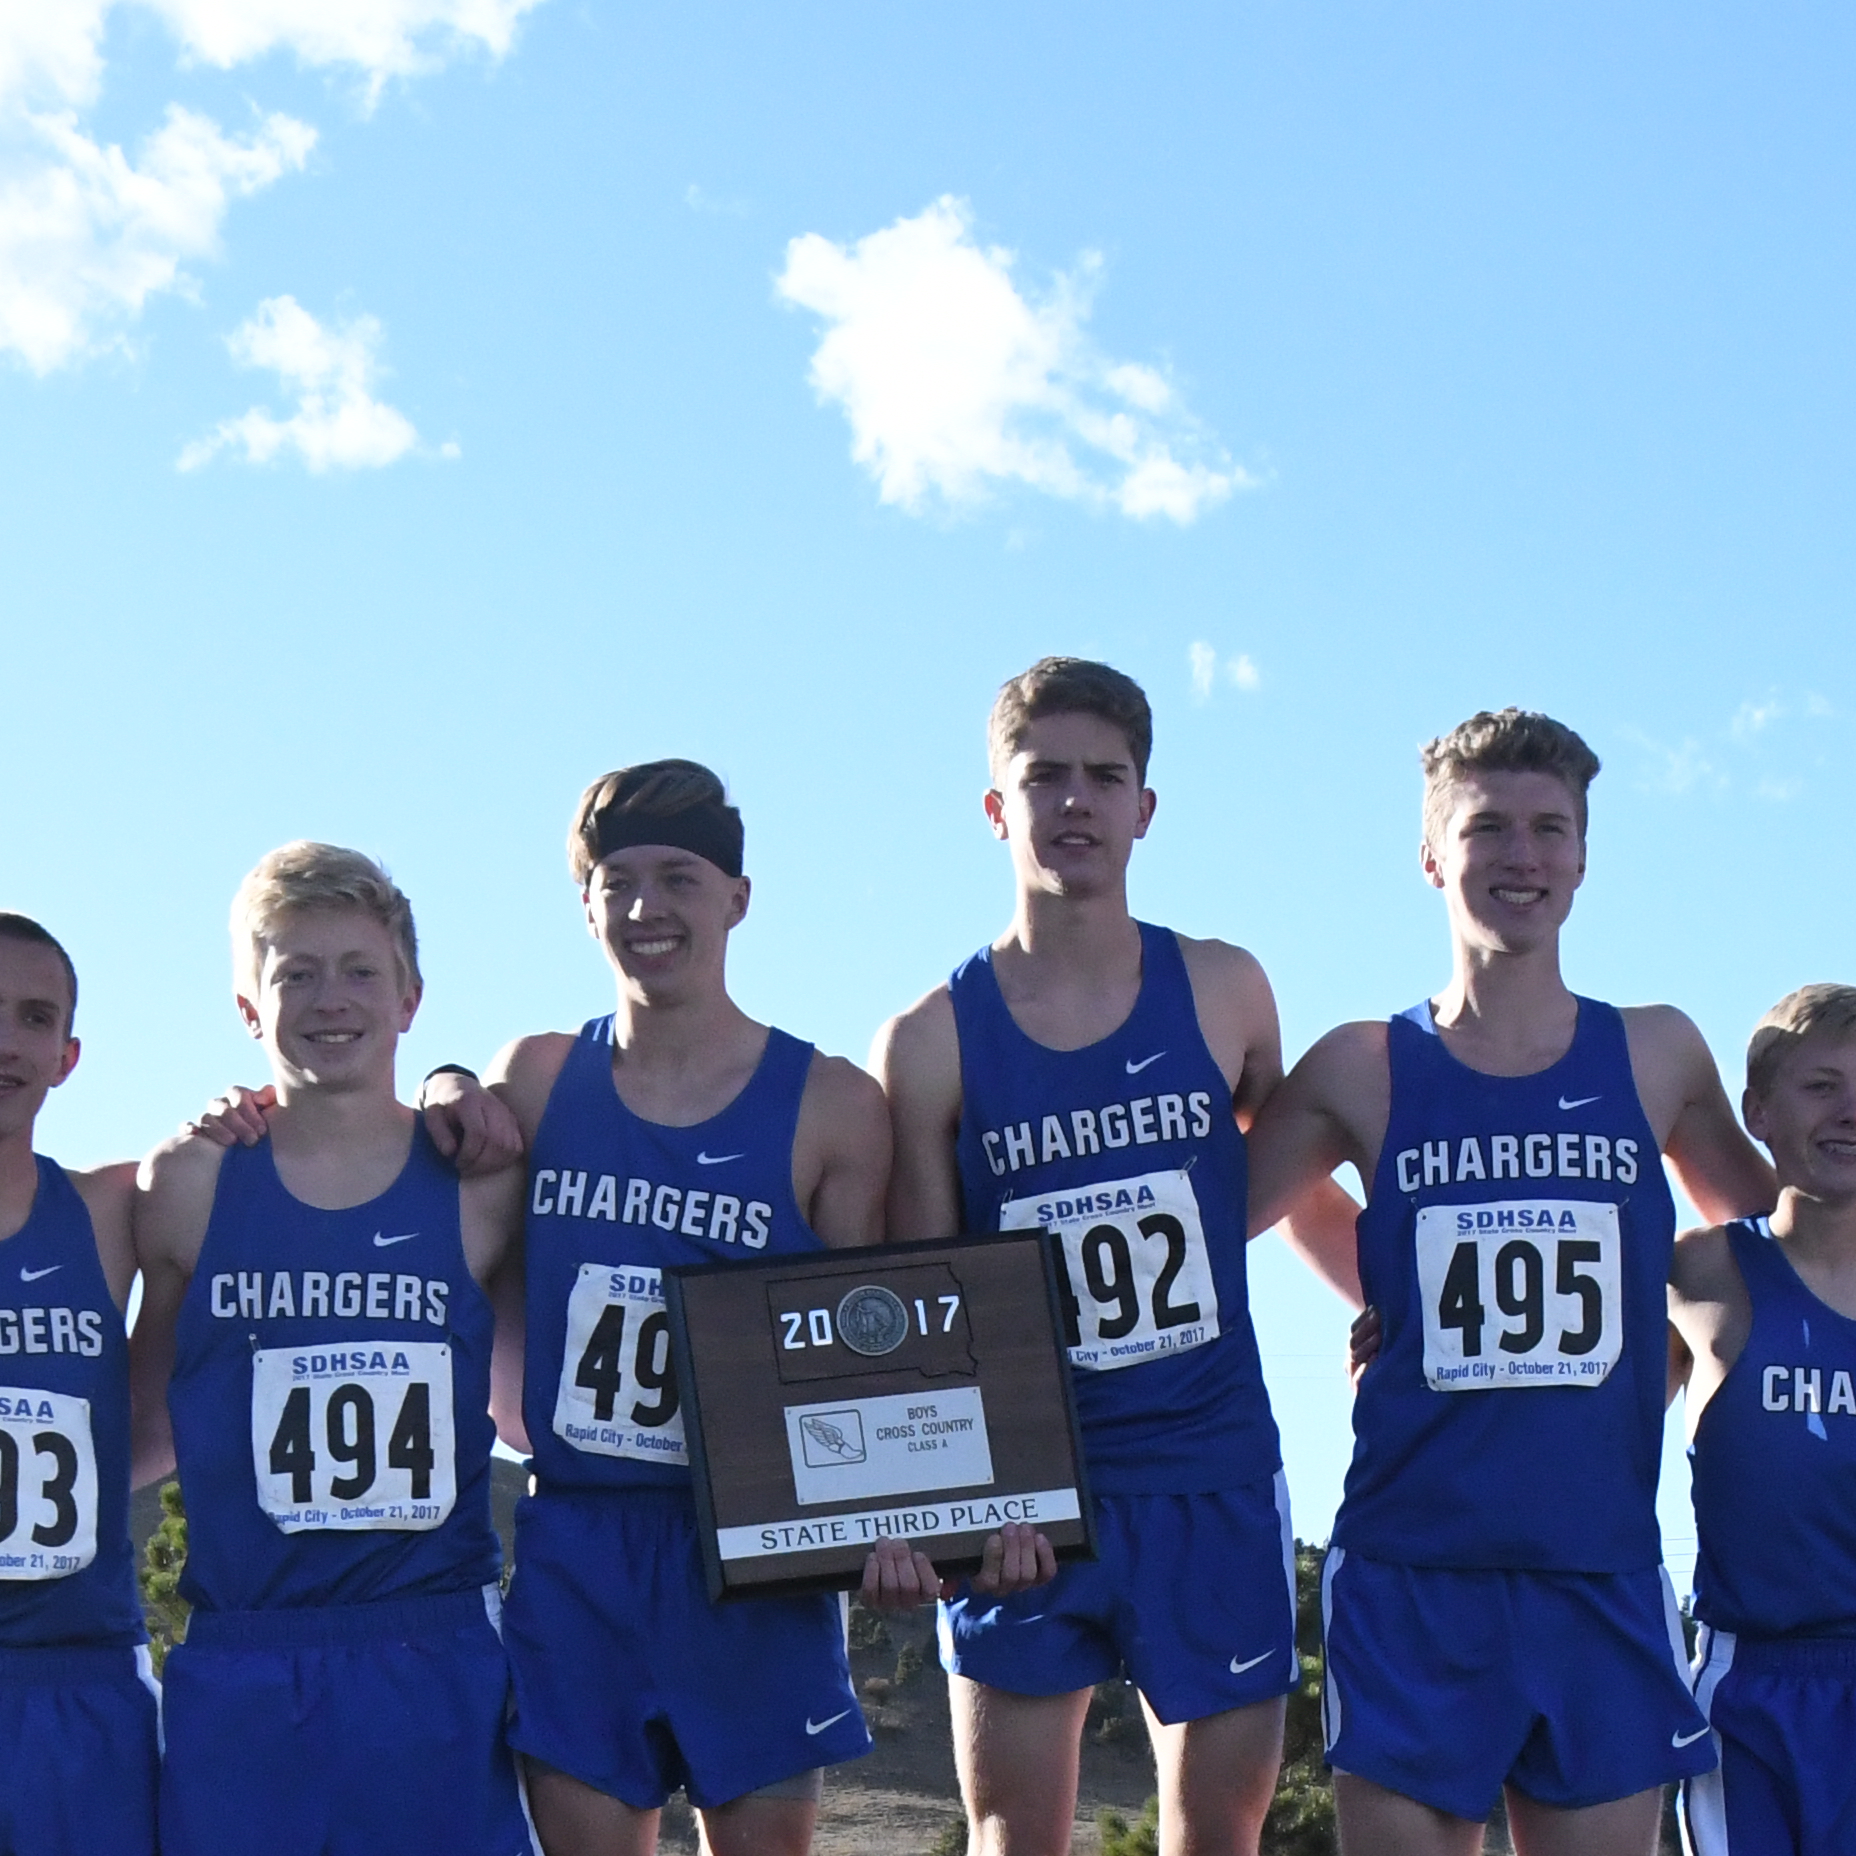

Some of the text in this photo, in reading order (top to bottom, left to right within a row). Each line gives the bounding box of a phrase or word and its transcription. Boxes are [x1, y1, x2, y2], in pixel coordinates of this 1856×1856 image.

[981, 1091, 1211, 1177] CHARGERS
[1396, 1133, 1638, 1193] CHARGERS
[532, 1169, 772, 1249] CHARGERS
[1036, 1184, 1156, 1223] SDHSAA
[1456, 1209, 1577, 1230] SDHSAA
[211, 1271, 450, 1327] CHARGERS
[609, 1273, 666, 1298] SDH
[1439, 1239, 1602, 1358] 495
[780, 1308, 834, 1350] 20
[914, 1295, 960, 1336] 17
[292, 1351, 410, 1375] SDHSAA
[1076, 1350, 1099, 1363] City
[1110, 1340, 1156, 1357] October
[1158, 1334, 1177, 1349] 21,
[1179, 1327, 1205, 1346] 2017
[575, 1303, 681, 1428] 49
[1436, 1364, 1469, 1382] Rapid
[1472, 1363, 1495, 1379] City
[1508, 1361, 1554, 1375] October
[1558, 1362, 1577, 1376] 21,
[1580, 1362, 1608, 1376] 2017
[876, 1418, 974, 1440] CROSS COUNTRY
[907, 1405, 938, 1420] BOYS
[269, 1382, 434, 1504] 494
[565, 1423, 598, 1441] Rapid
[600, 1428, 624, 1447] City
[635, 1432, 683, 1452] October
[907, 1438, 948, 1452] CLASS A
[304, 1510, 328, 1524] City
[340, 1506, 385, 1520] October
[389, 1506, 408, 1521] 21,
[411, 1505, 441, 1519] 2017
[760, 1498, 1039, 1550] STATE THIRD PLACE
[30, 1554, 49, 1571] 21,
[52, 1555, 81, 1570] 2017
